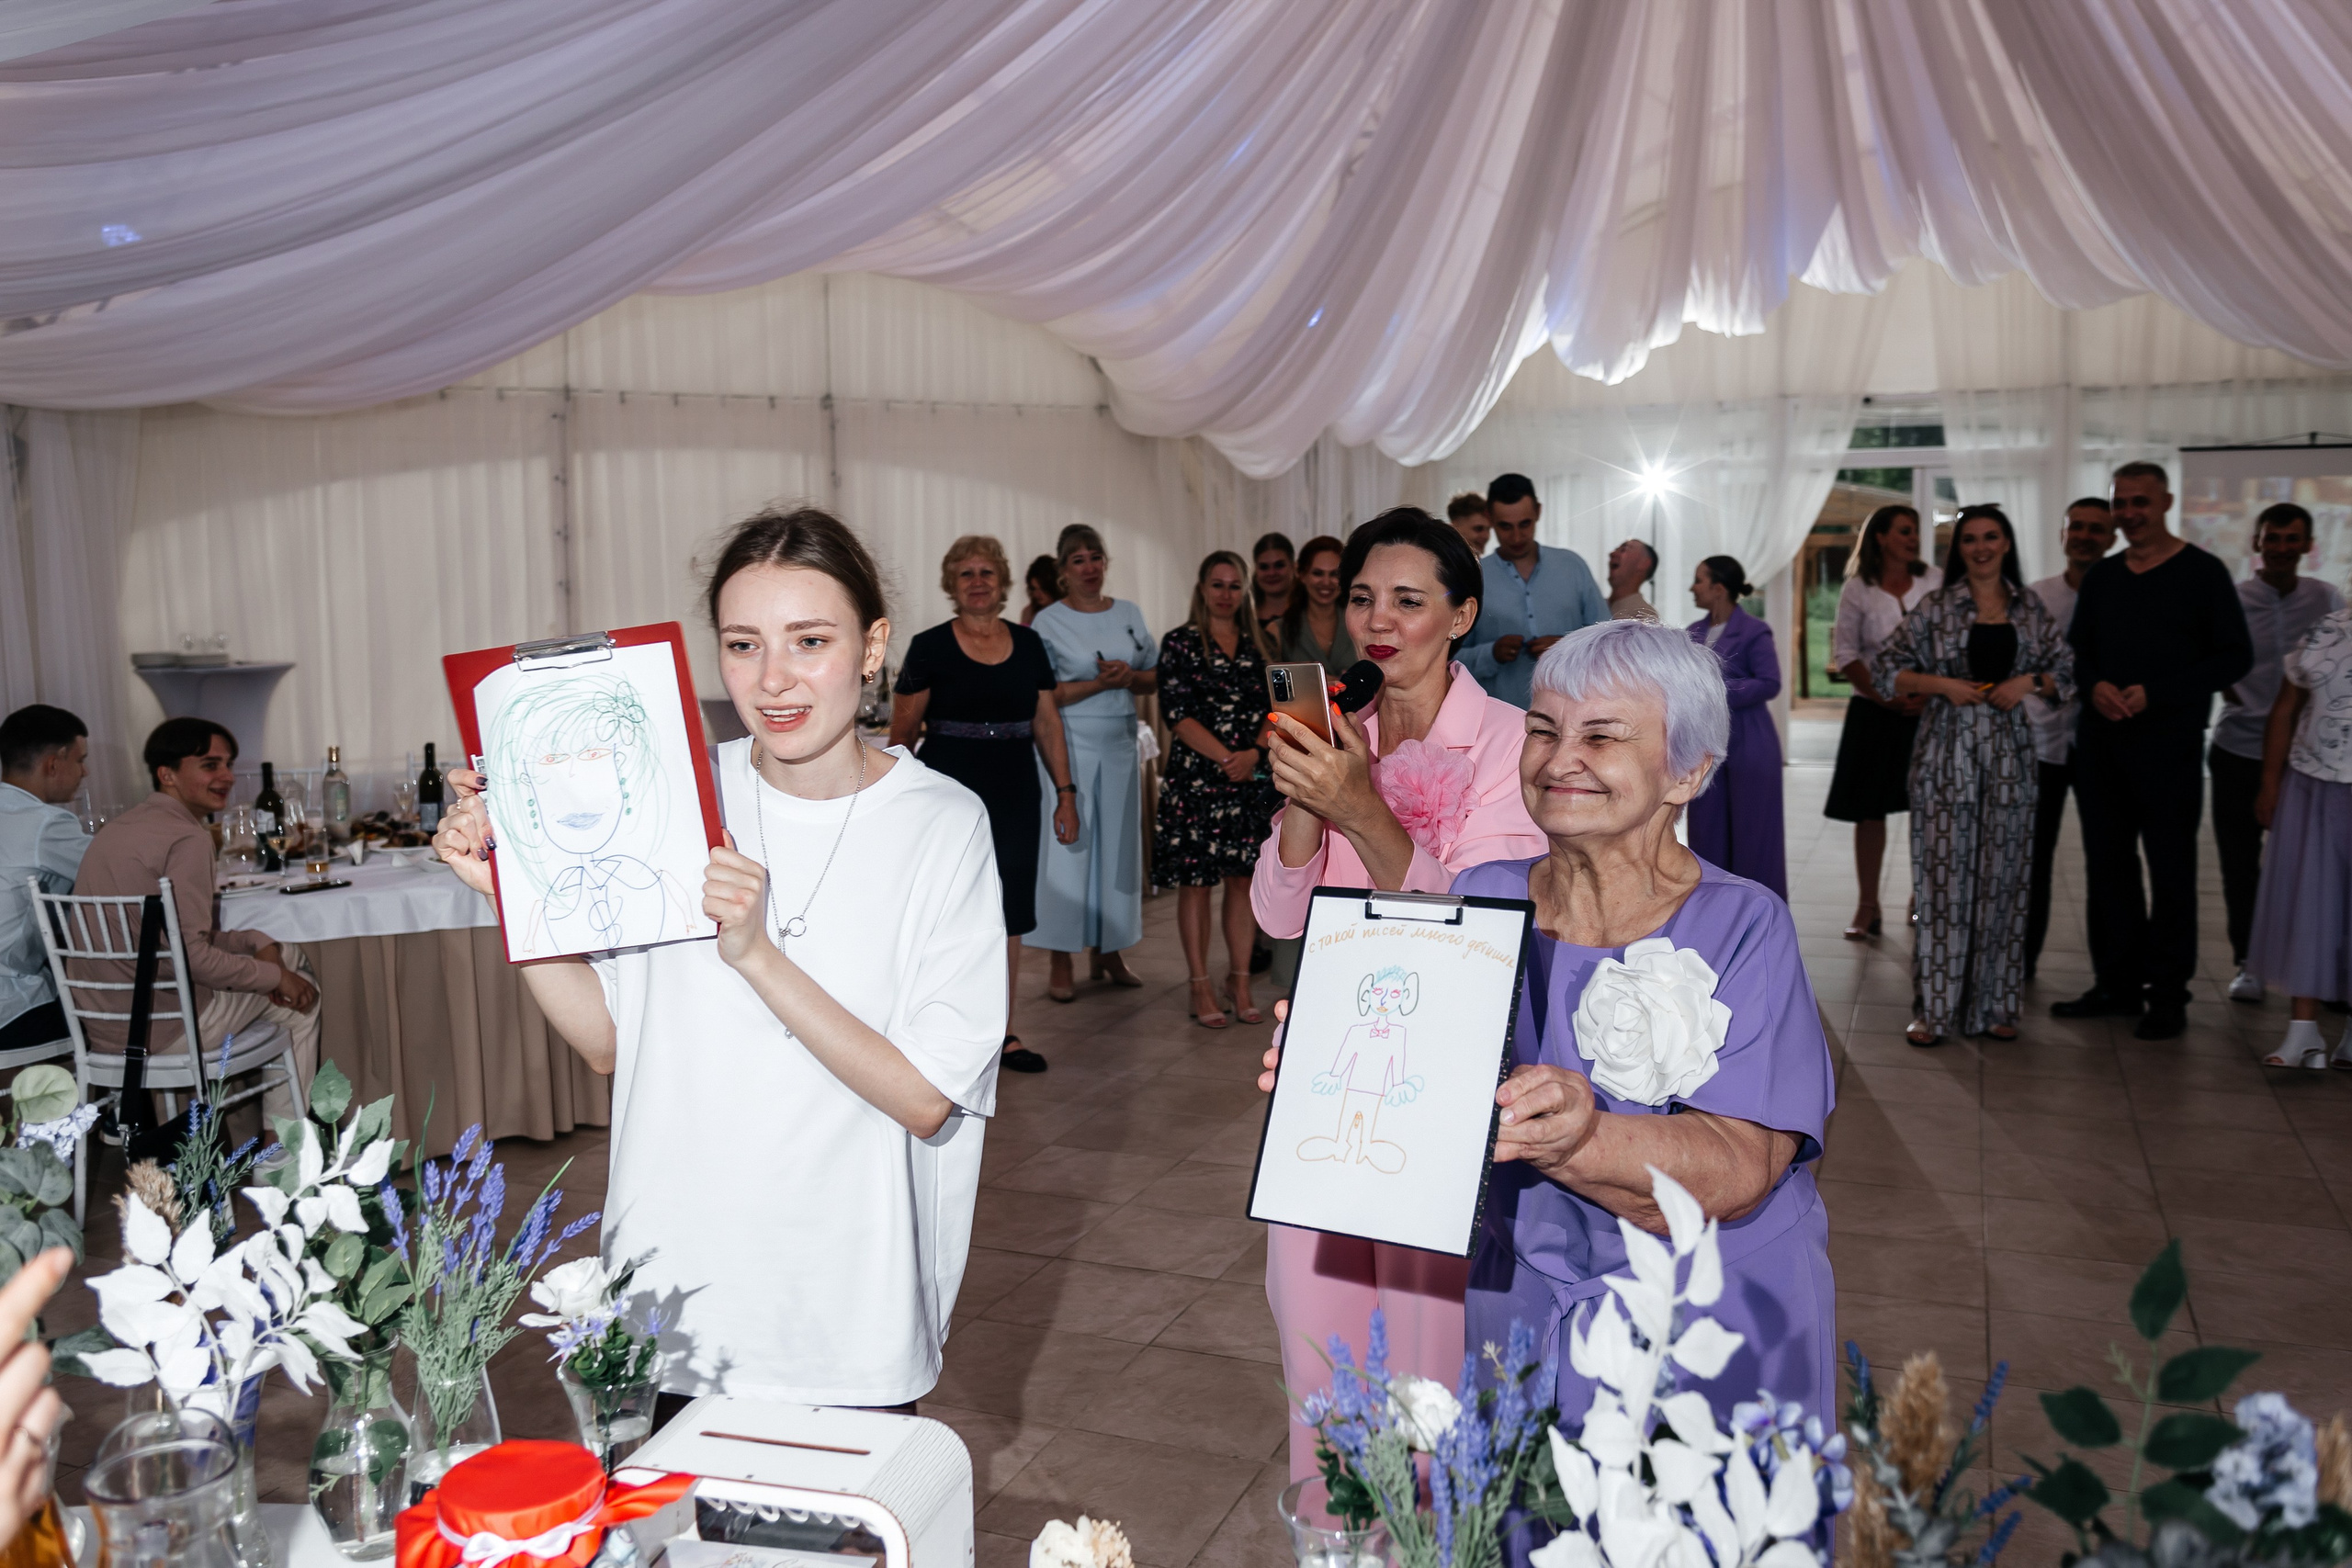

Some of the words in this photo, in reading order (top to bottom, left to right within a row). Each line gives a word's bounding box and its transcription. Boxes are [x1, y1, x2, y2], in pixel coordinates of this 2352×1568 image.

[1318, 922, 1358, 951] такой
[1363, 924, 1408, 938] писей
[1410, 926, 1464, 945] много
